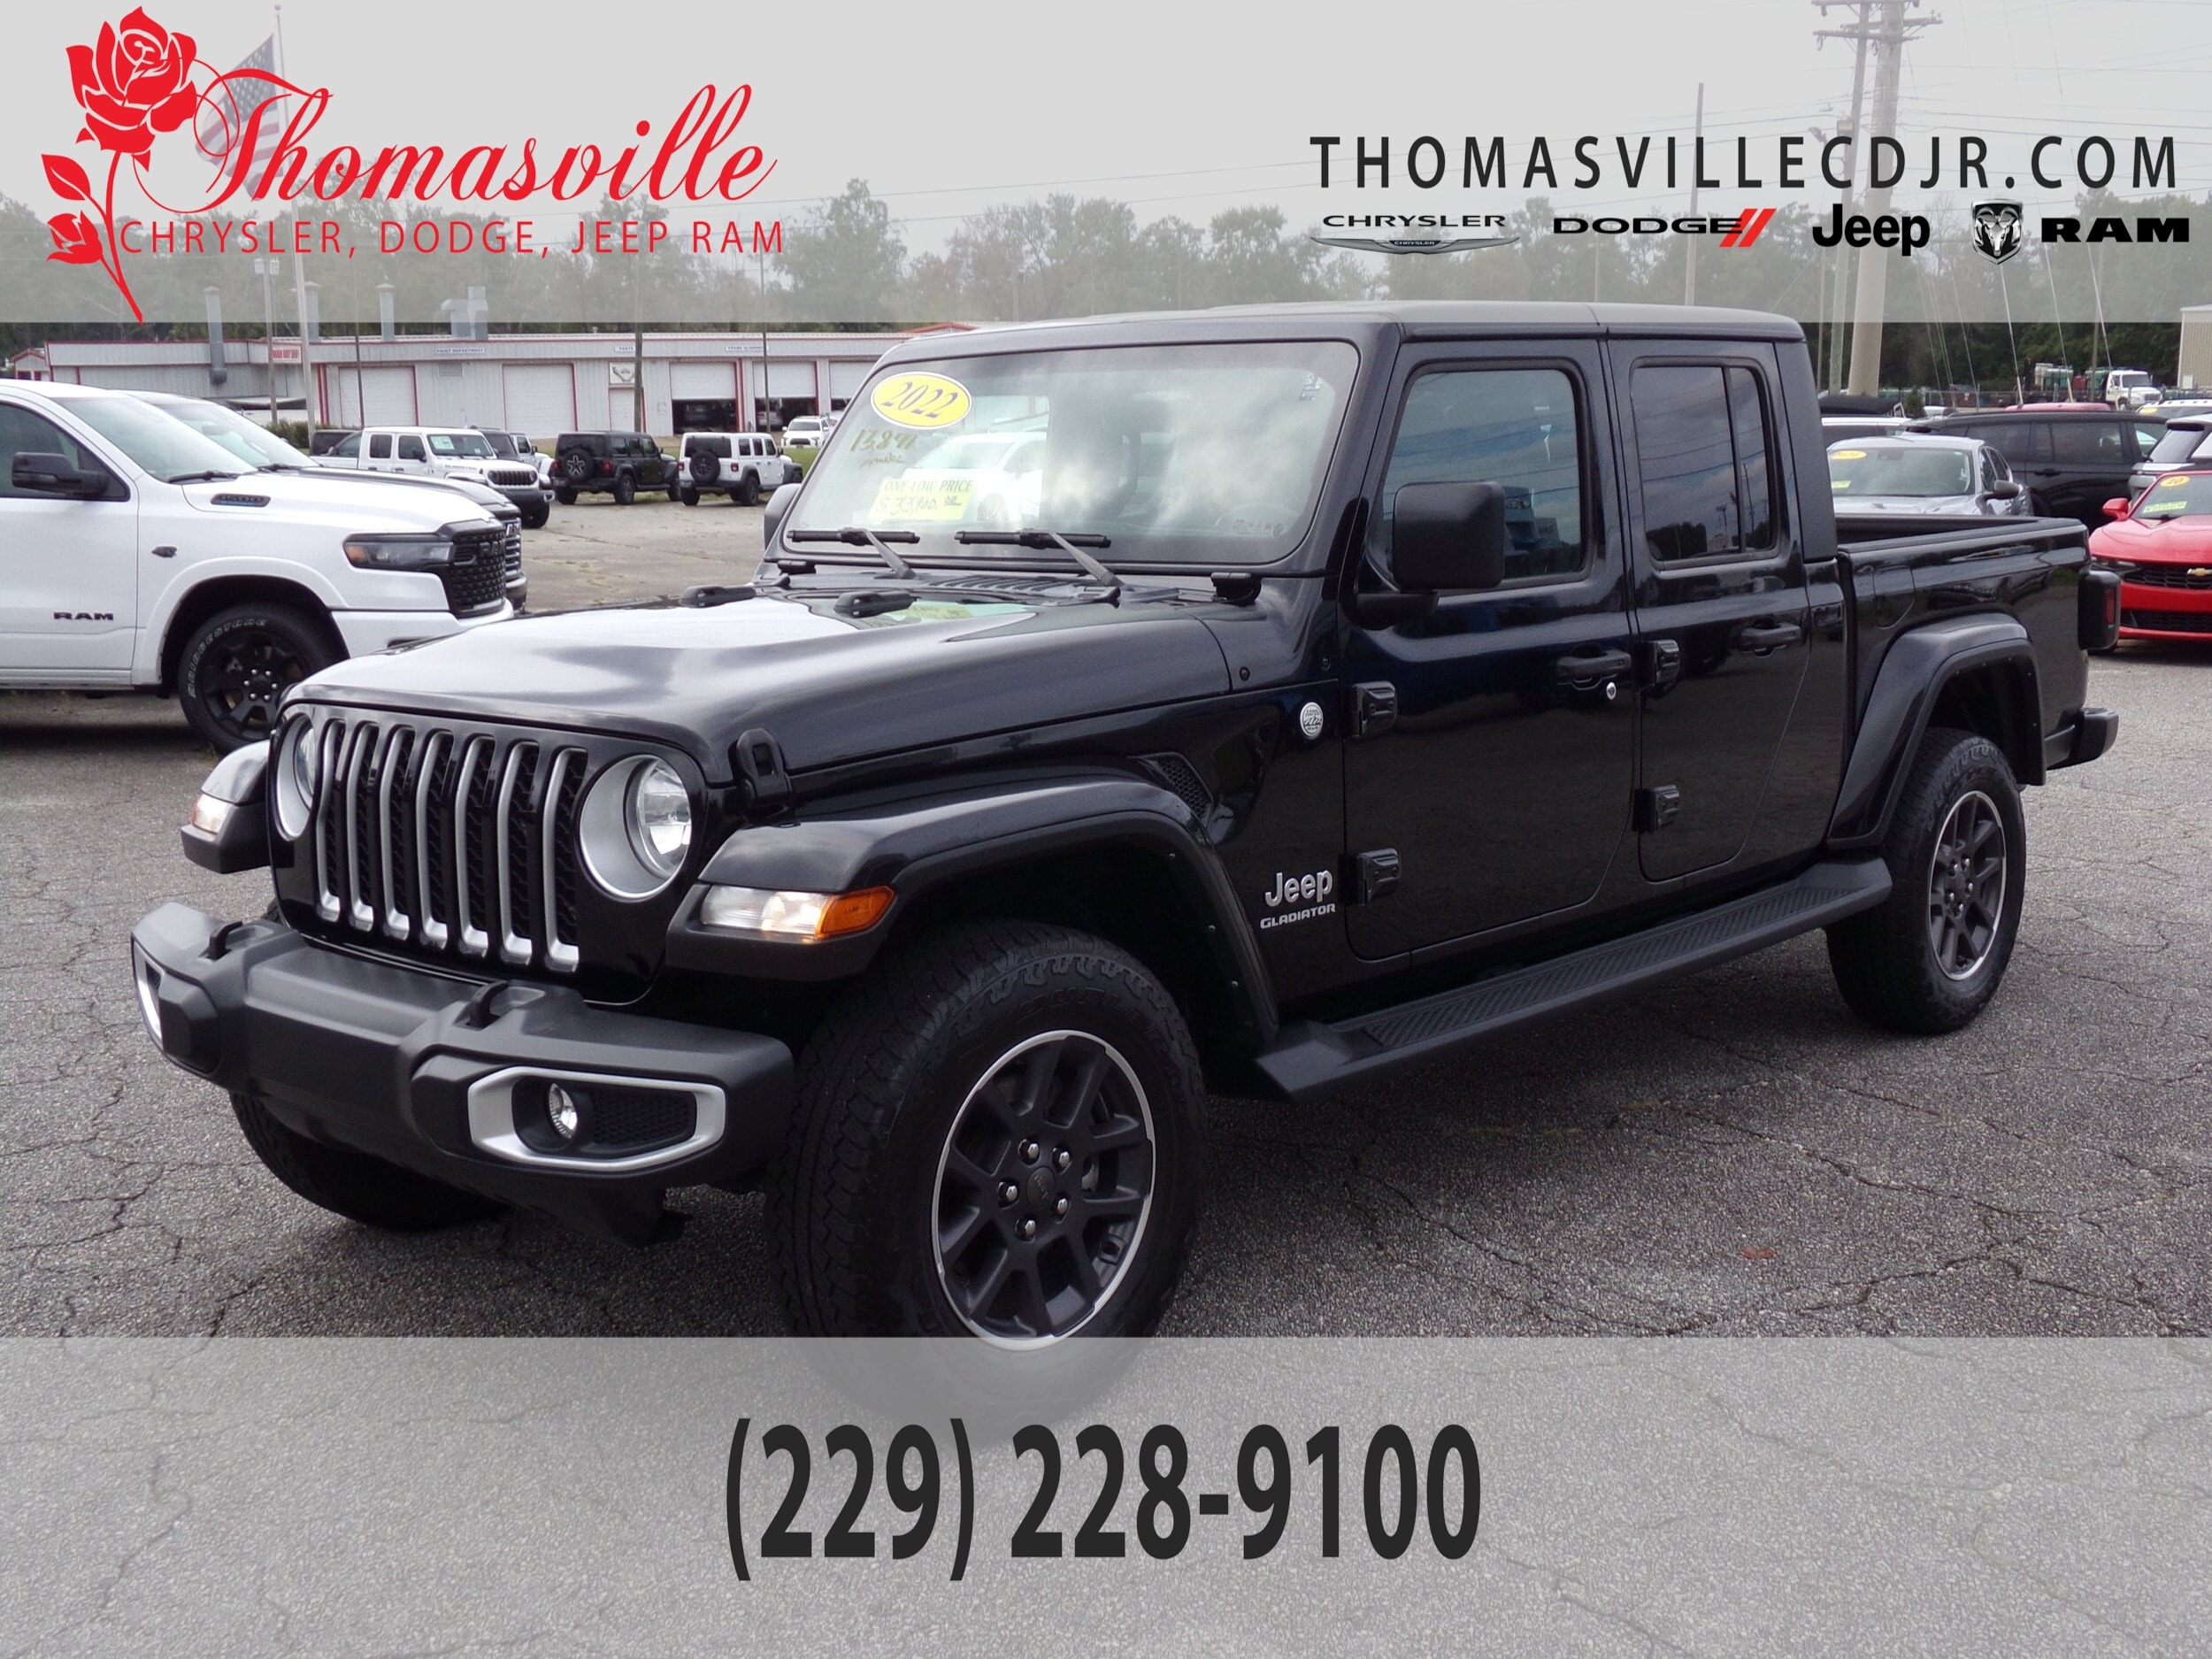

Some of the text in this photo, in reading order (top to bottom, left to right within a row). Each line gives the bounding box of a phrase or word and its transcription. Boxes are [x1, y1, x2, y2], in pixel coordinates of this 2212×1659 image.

[880, 381, 958, 419] 2022
[884, 480, 974, 492] ONE LOW PRICE
[53, 611, 114, 621] RAM
[1264, 869, 1333, 908] Jeep
[1260, 902, 1336, 929] GLADIATOR
